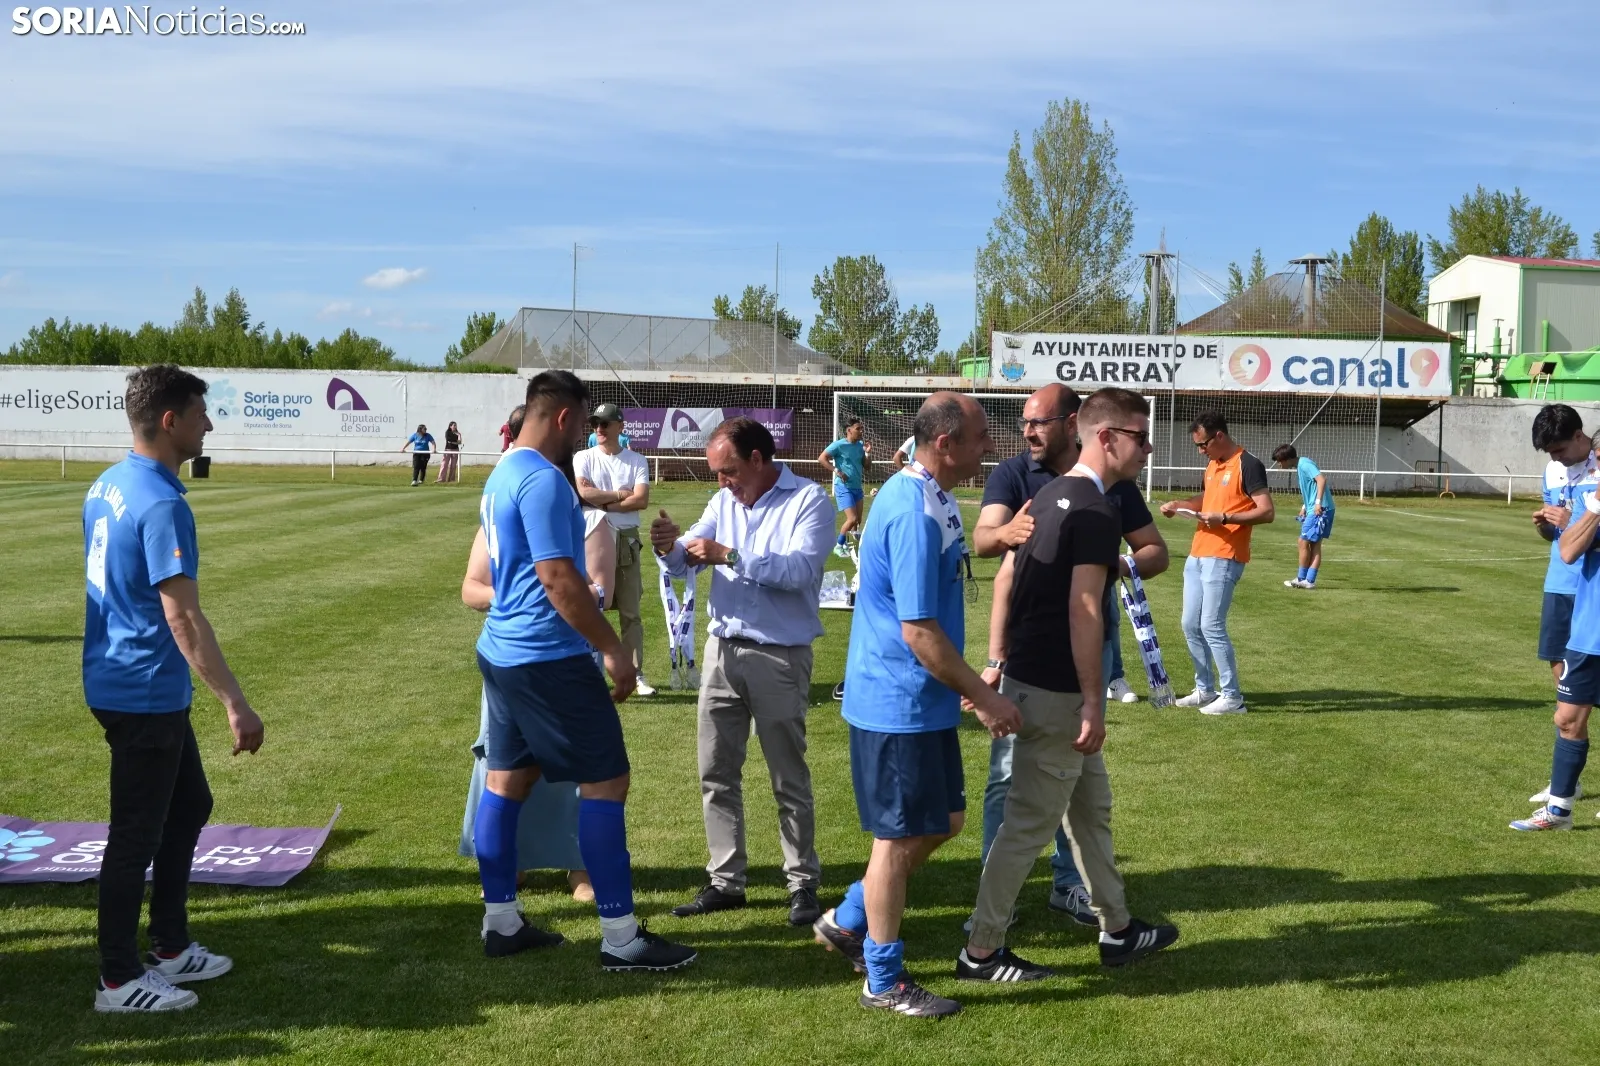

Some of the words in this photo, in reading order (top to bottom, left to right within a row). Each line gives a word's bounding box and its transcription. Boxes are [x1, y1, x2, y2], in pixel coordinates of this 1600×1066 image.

[1031, 341, 1187, 358] AYUNTAMIENTO
[1193, 344, 1218, 359] DE
[1055, 360, 1182, 383] GARRAY
[0, 388, 126, 414] #eligeSoria
[243, 391, 280, 404] Soria
[283, 394, 313, 408] puro
[243, 404, 301, 421] Oxígeno
[341, 412, 395, 424] Diputación
[341, 423, 353, 433] de
[355, 423, 381, 433] Soria
[622, 420, 642, 429] Soria
[643, 421, 661, 429] puro
